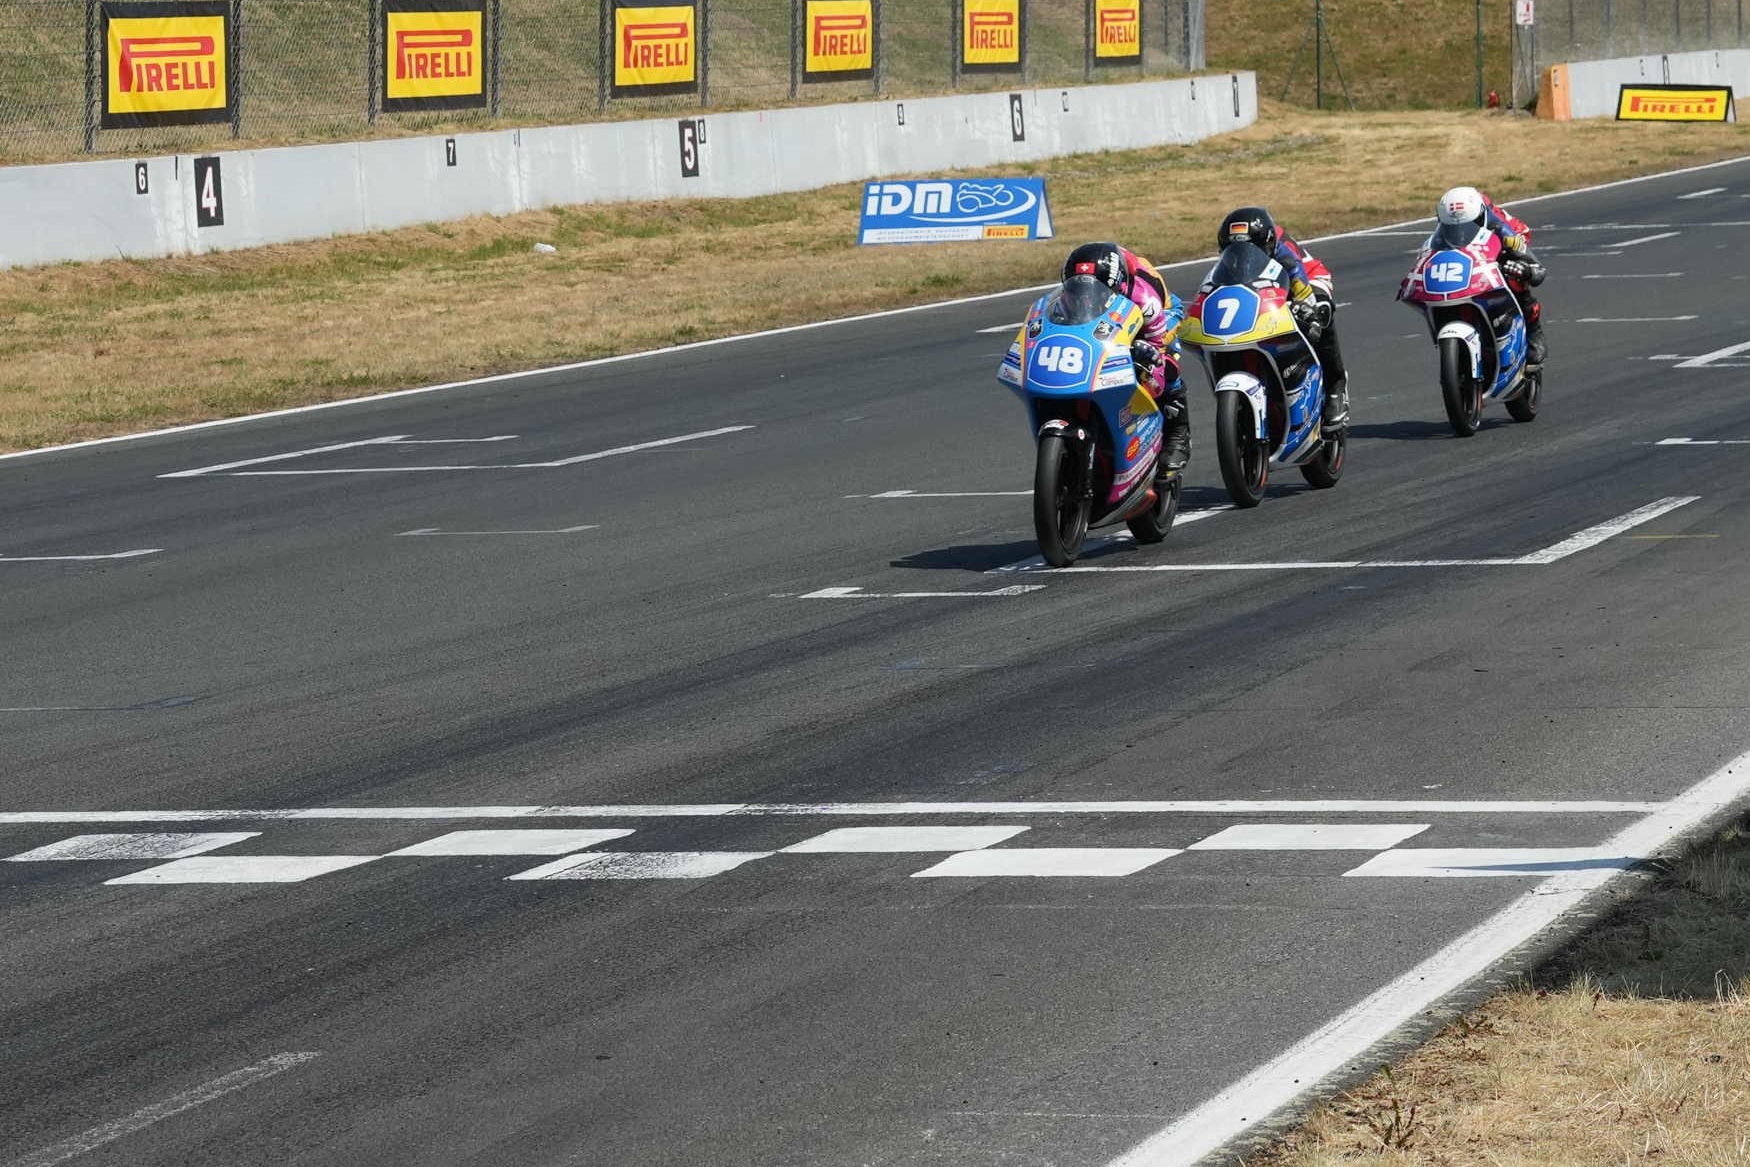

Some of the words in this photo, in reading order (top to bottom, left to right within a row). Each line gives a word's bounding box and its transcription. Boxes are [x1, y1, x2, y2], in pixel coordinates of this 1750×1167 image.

[813, 14, 868, 57] PIRELLI
[969, 11, 1014, 50] PIRELLI
[1100, 8, 1137, 44] PIRELLI
[396, 29, 473, 80] PIRELLI
[623, 22, 689, 69] PIRELLI
[119, 36, 216, 93] PIRELLI
[1013, 99, 1023, 136] 6
[1630, 95, 1717, 114] PIRELLI
[699, 121, 705, 142] 8
[447, 142, 455, 164] 7
[684, 127, 695, 170] 5
[138, 166, 146, 191] 6
[201, 166, 217, 218] 4
[986, 227, 1025, 237] PIRELLI
[1430, 262, 1464, 283] 42
[1217, 298, 1240, 329] 7
[1038, 346, 1083, 374] 48
[1139, 416, 1161, 444] SPORT
